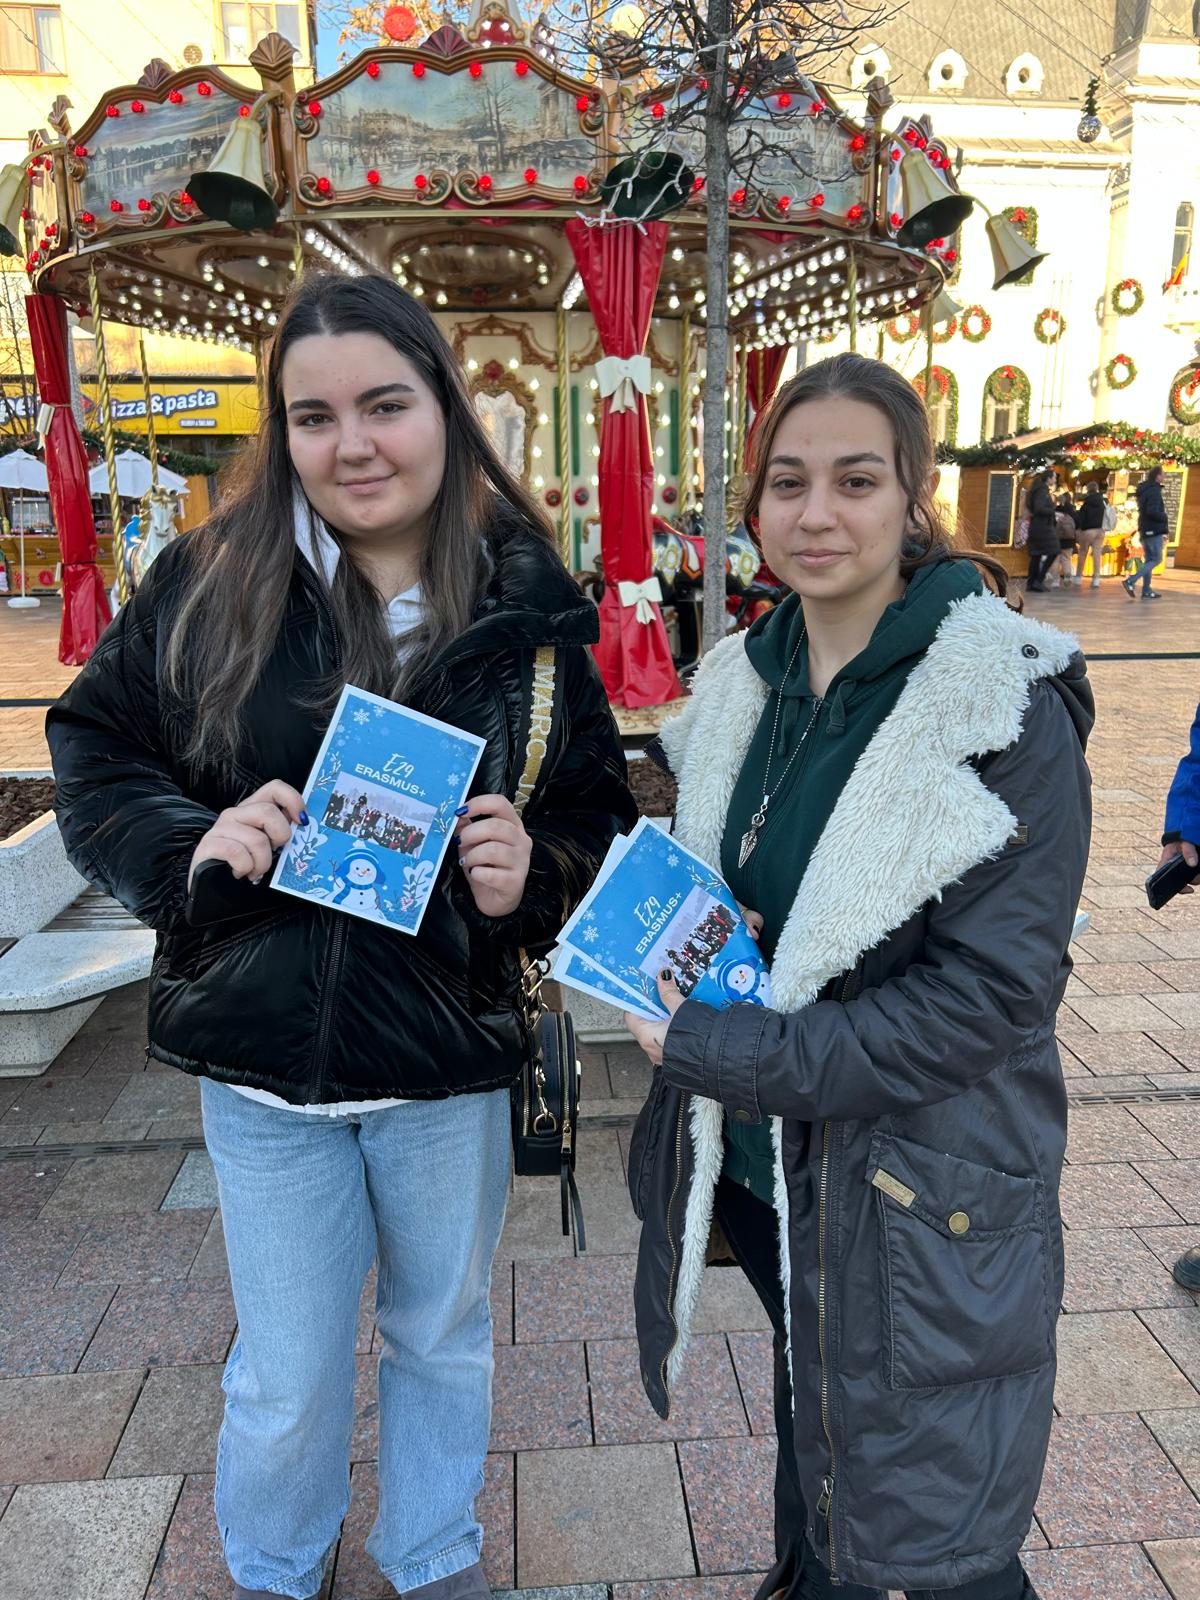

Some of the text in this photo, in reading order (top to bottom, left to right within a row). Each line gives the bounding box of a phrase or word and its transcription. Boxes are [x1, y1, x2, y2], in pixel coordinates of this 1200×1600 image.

[526, 662, 556, 759] MARC
[354, 763, 426, 797] ERASMUS+
[635, 892, 682, 954] ERASMUS+
